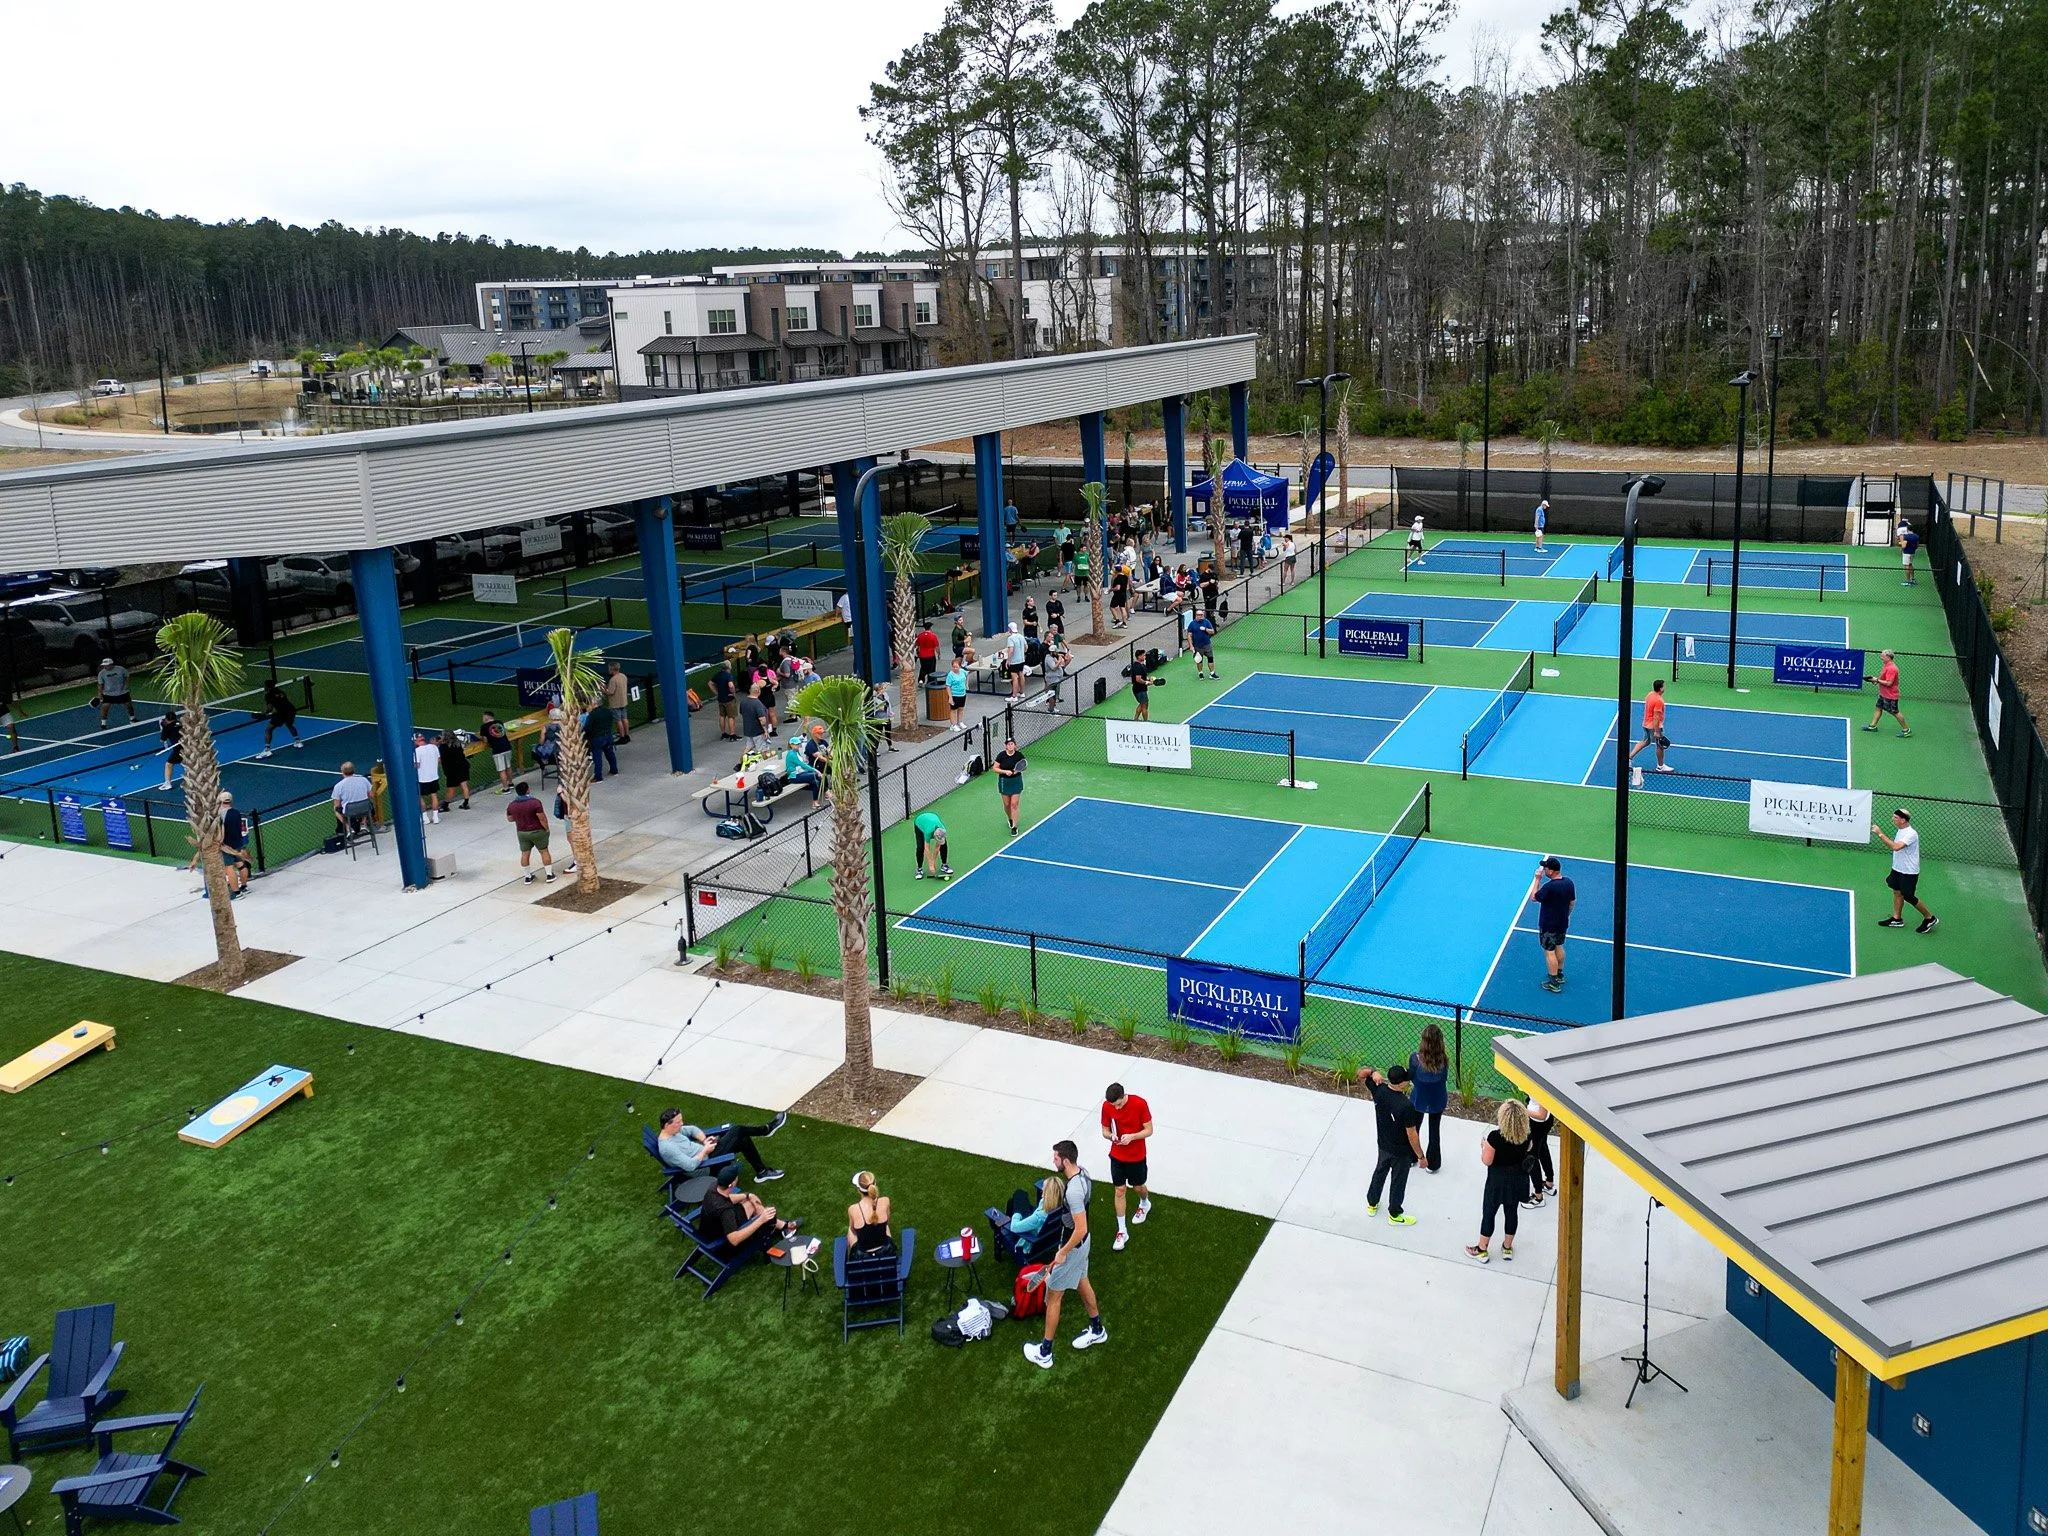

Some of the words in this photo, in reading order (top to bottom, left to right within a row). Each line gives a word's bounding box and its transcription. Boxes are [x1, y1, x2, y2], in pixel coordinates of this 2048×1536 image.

[1345, 629, 1403, 642] PICKLEBALL
[1783, 656, 1856, 670] PICKLEBALL
[1787, 667, 1850, 675] CHARLESTON
[1116, 733, 1181, 747] PICKLEBALL
[1118, 744, 1179, 752] CHARLESTON
[1764, 797, 1857, 817] PICKLEBALL
[1766, 810, 1854, 823] CHARLESTON
[1179, 977, 1289, 1012] PICKLEBALL
[1187, 996, 1279, 1019] CHARLESTON
